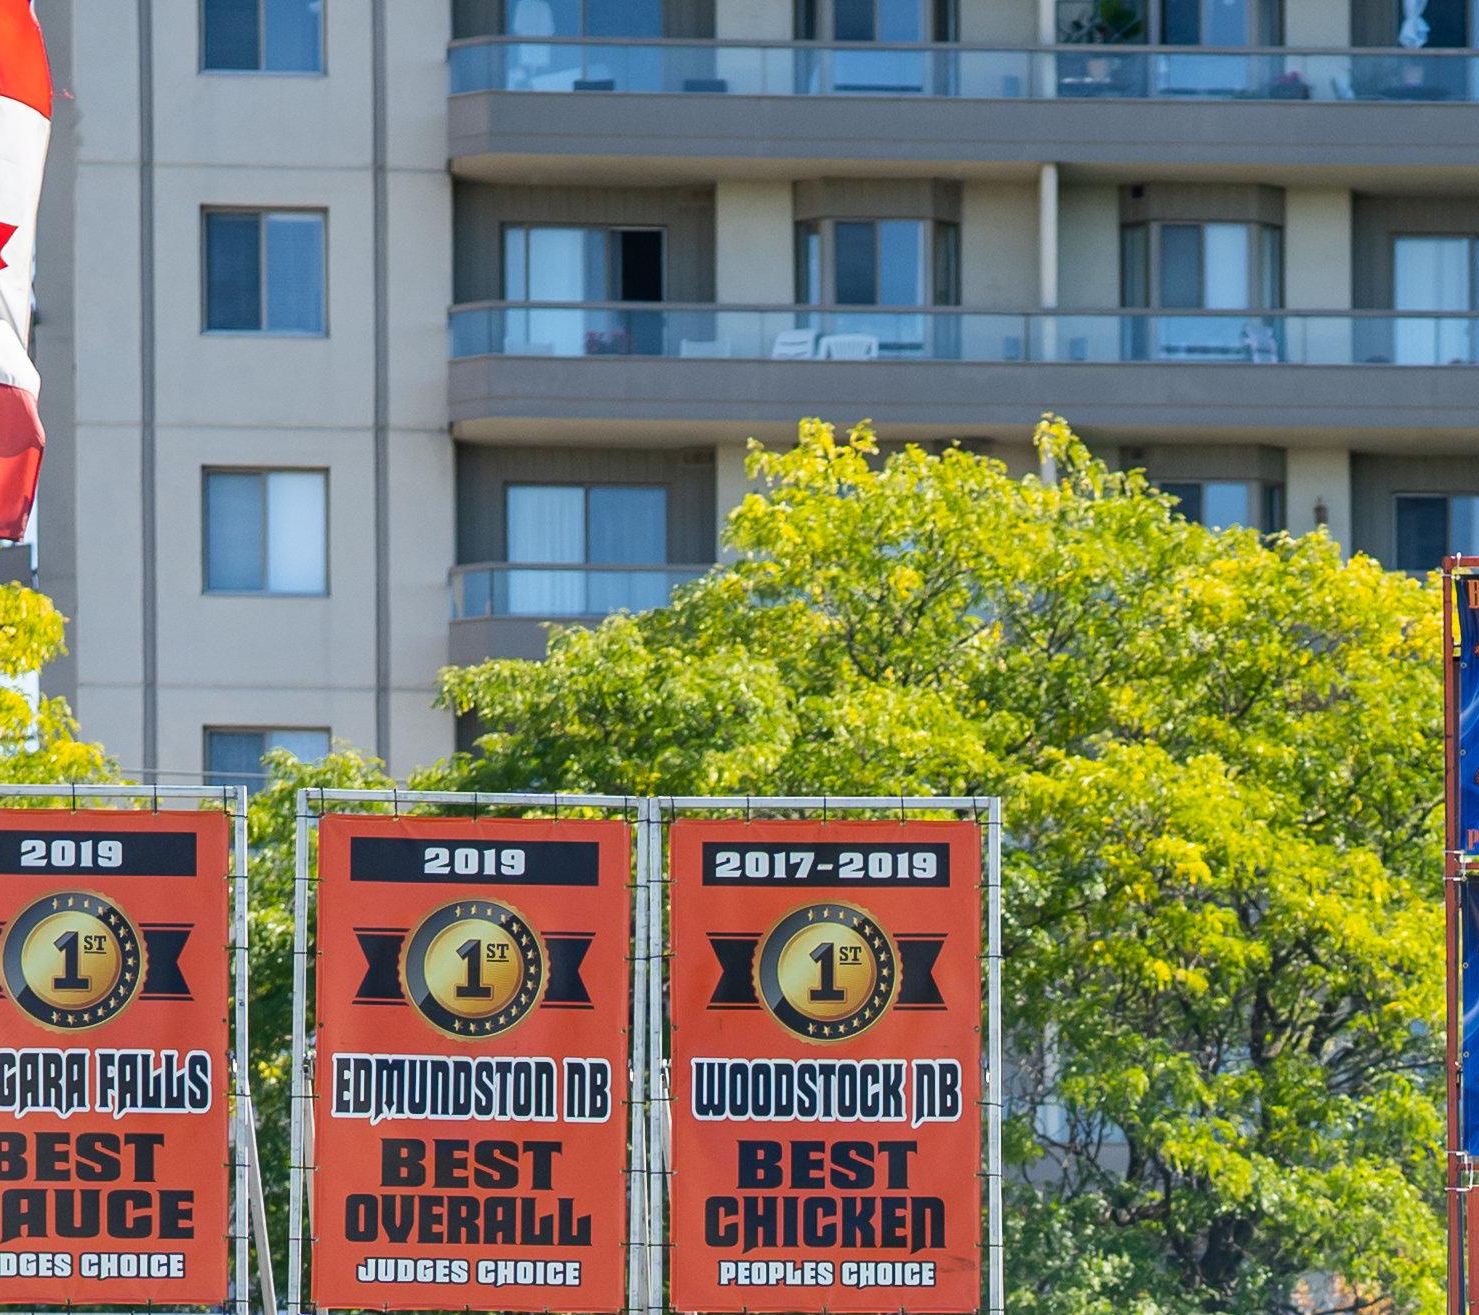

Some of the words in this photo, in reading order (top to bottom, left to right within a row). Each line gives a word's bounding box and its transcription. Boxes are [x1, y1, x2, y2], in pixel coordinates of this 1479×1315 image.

[20, 839, 123, 868] 2019
[715, 851, 938, 880] 2017-2019
[51, 931, 107, 991] 1ST
[809, 942, 862, 1002] 1ST
[94, 1048, 212, 1119] FALLS
[691, 1057, 910, 1122] WOODSTOCK
[913, 1058, 962, 1129] NB
[736, 1140, 917, 1190] BEST
[704, 1196, 946, 1254] CHICKEN
[79, 1252, 185, 1280] CHOICE
[718, 1261, 835, 1287] PEOPLES
[840, 1261, 936, 1289] CHOICE
